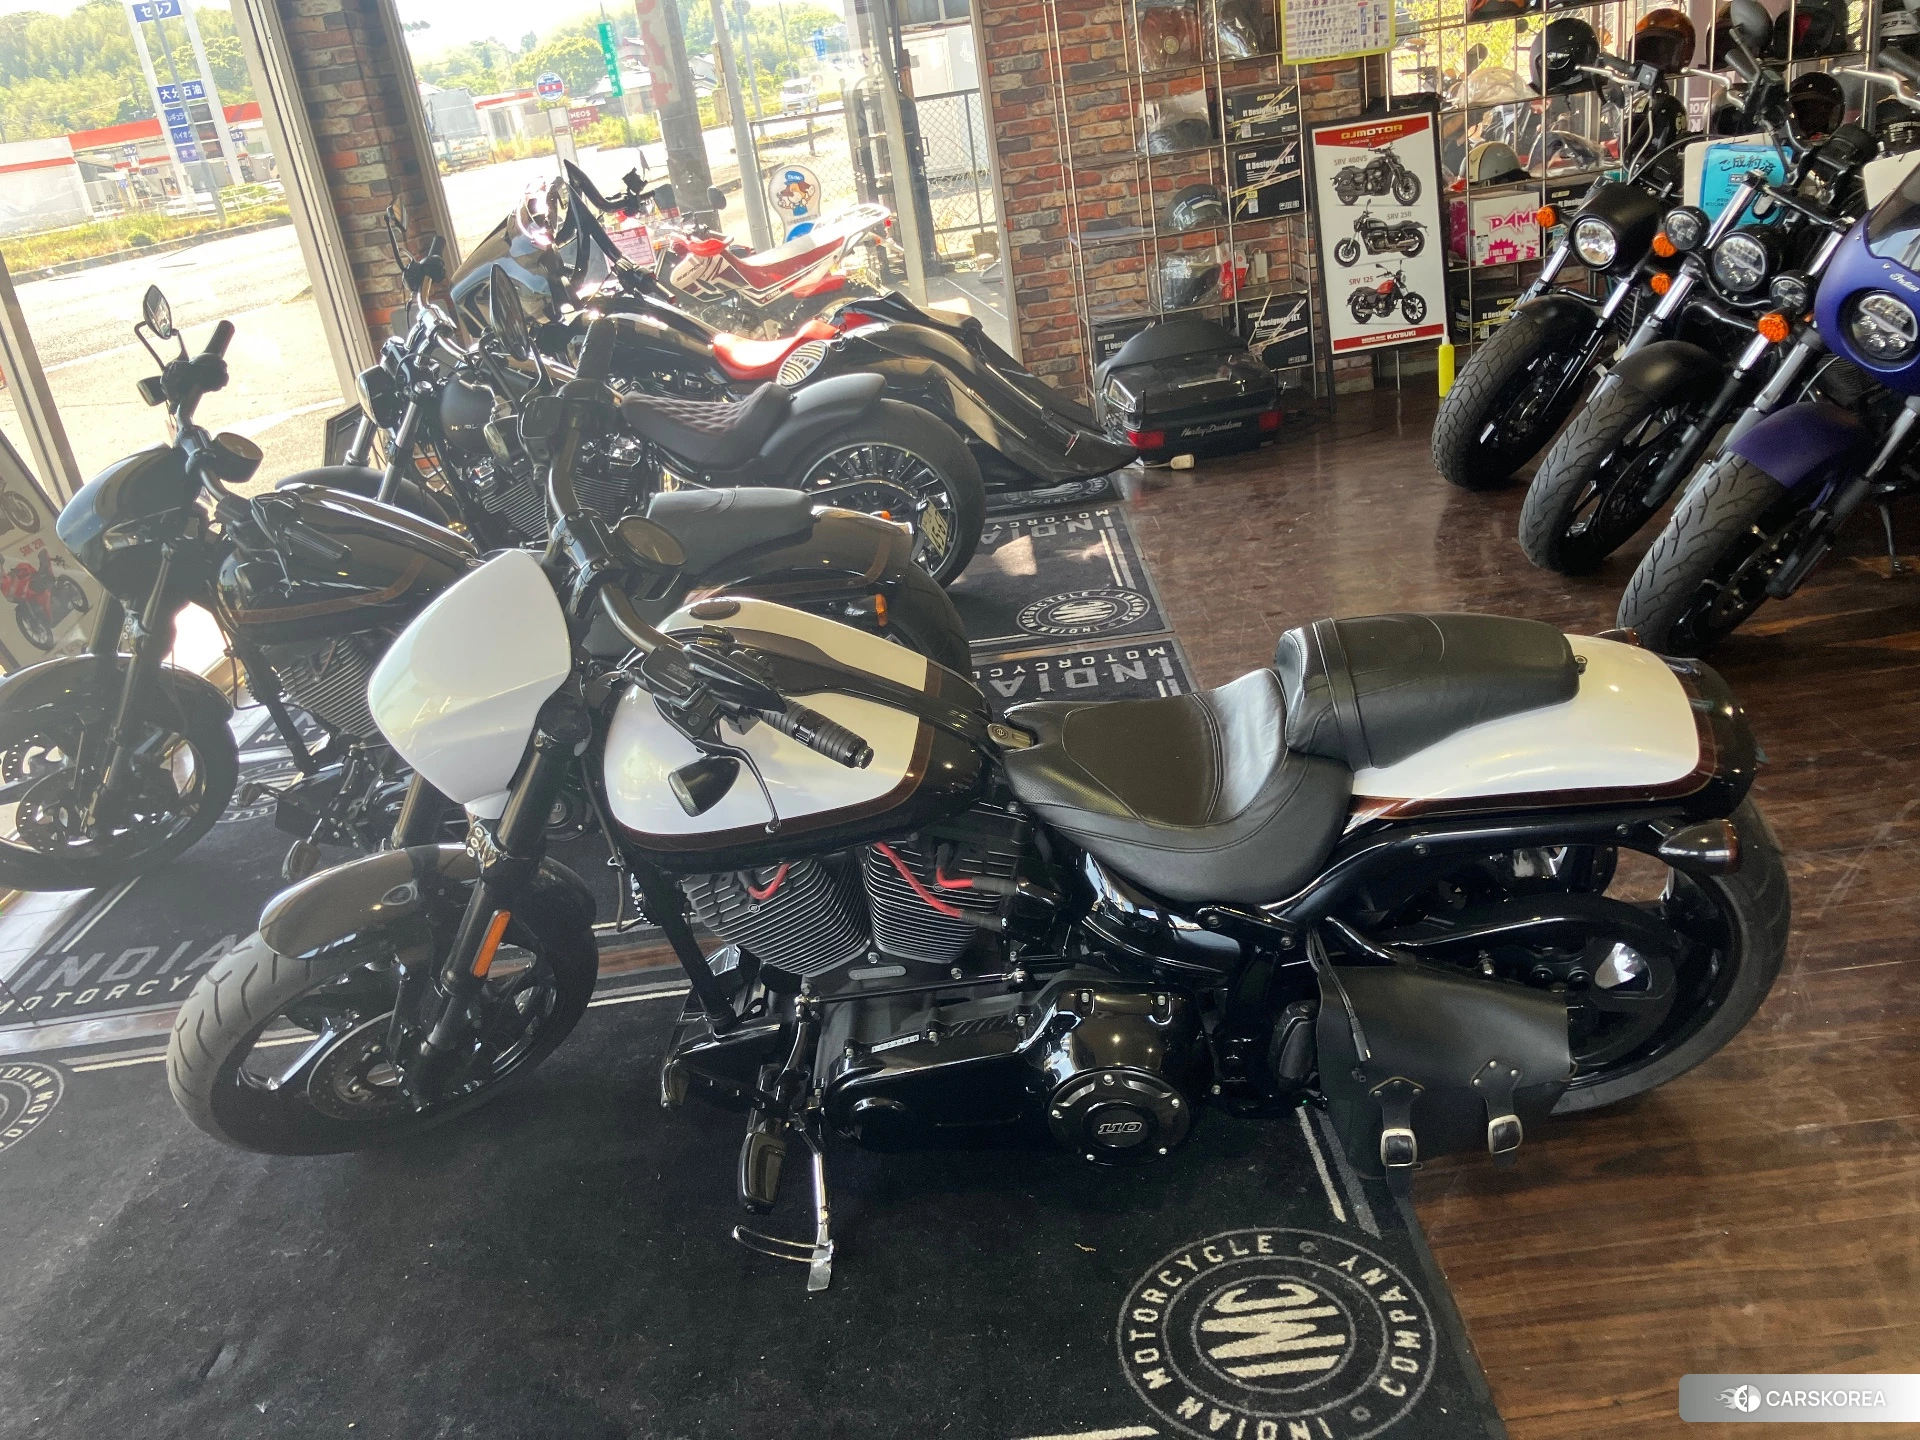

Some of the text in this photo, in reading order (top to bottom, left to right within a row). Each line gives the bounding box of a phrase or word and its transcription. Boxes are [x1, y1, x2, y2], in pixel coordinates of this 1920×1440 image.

[160, 84, 203, 100] 大分石油
[1341, 124, 1403, 140] QJMOTOR
[1333, 158, 1347, 166] SRV
[1718, 154, 1776, 176] ご成約済
[1400, 210, 1412, 218] 250
[1348, 275, 1374, 286] SRV 125
[1386, 331, 1417, 341] KATSUKI
[1097, 1121, 1143, 1135] 110
[1129, 1233, 1422, 1440] MOTORCYCLE COMPANY INDIAN
